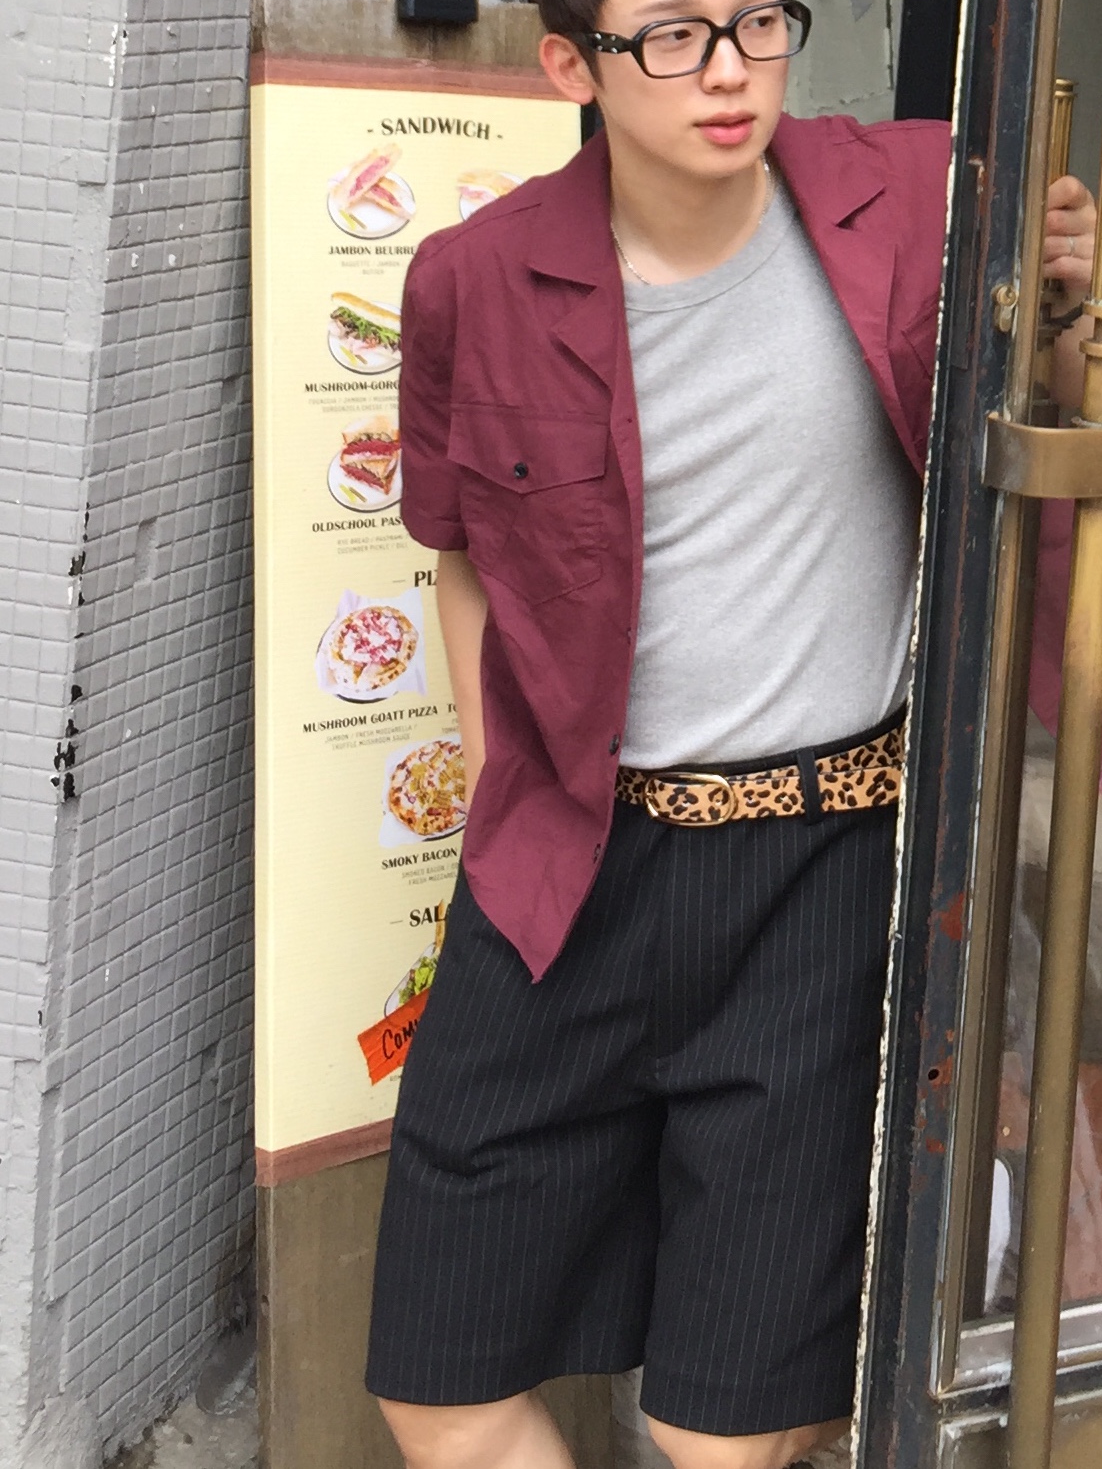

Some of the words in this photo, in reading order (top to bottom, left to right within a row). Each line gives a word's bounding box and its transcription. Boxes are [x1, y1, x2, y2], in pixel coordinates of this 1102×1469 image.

[381, 116, 491, 141] SANDWICH
[328, 245, 372, 256] JAMBON
[312, 517, 378, 533] OLDSCHOOL
[301, 715, 367, 734] MUSHROOM
[370, 709, 405, 724] GOATT
[408, 704, 439, 719] PIZZA
[381, 853, 419, 870] SMOKY
[421, 847, 458, 863] BACON
